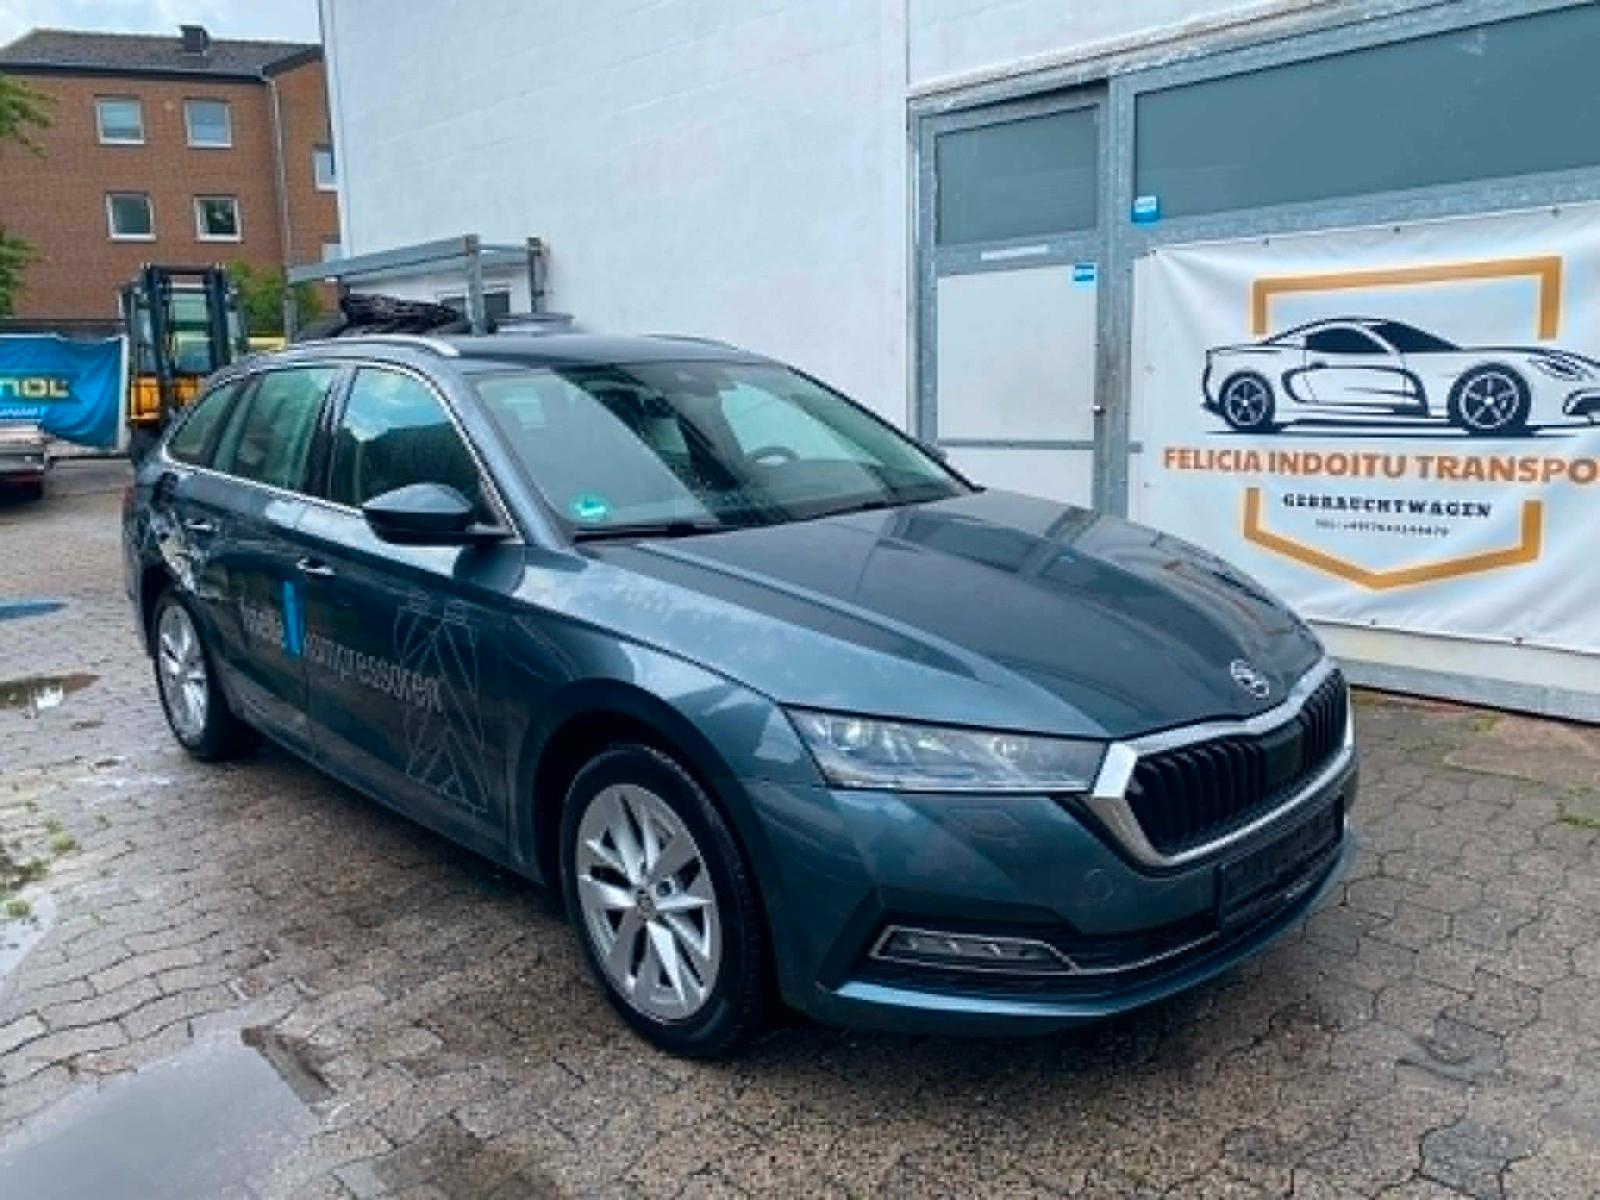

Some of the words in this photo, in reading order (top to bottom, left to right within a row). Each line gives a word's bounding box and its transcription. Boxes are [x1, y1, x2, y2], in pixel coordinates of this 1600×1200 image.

[1164, 447, 1263, 473] FELICIA
[1269, 452, 1406, 479] INDOITU
[1414, 455, 1599, 485] TRANSPO
[1282, 493, 1491, 518] GEBRAUCHTWAGEN
